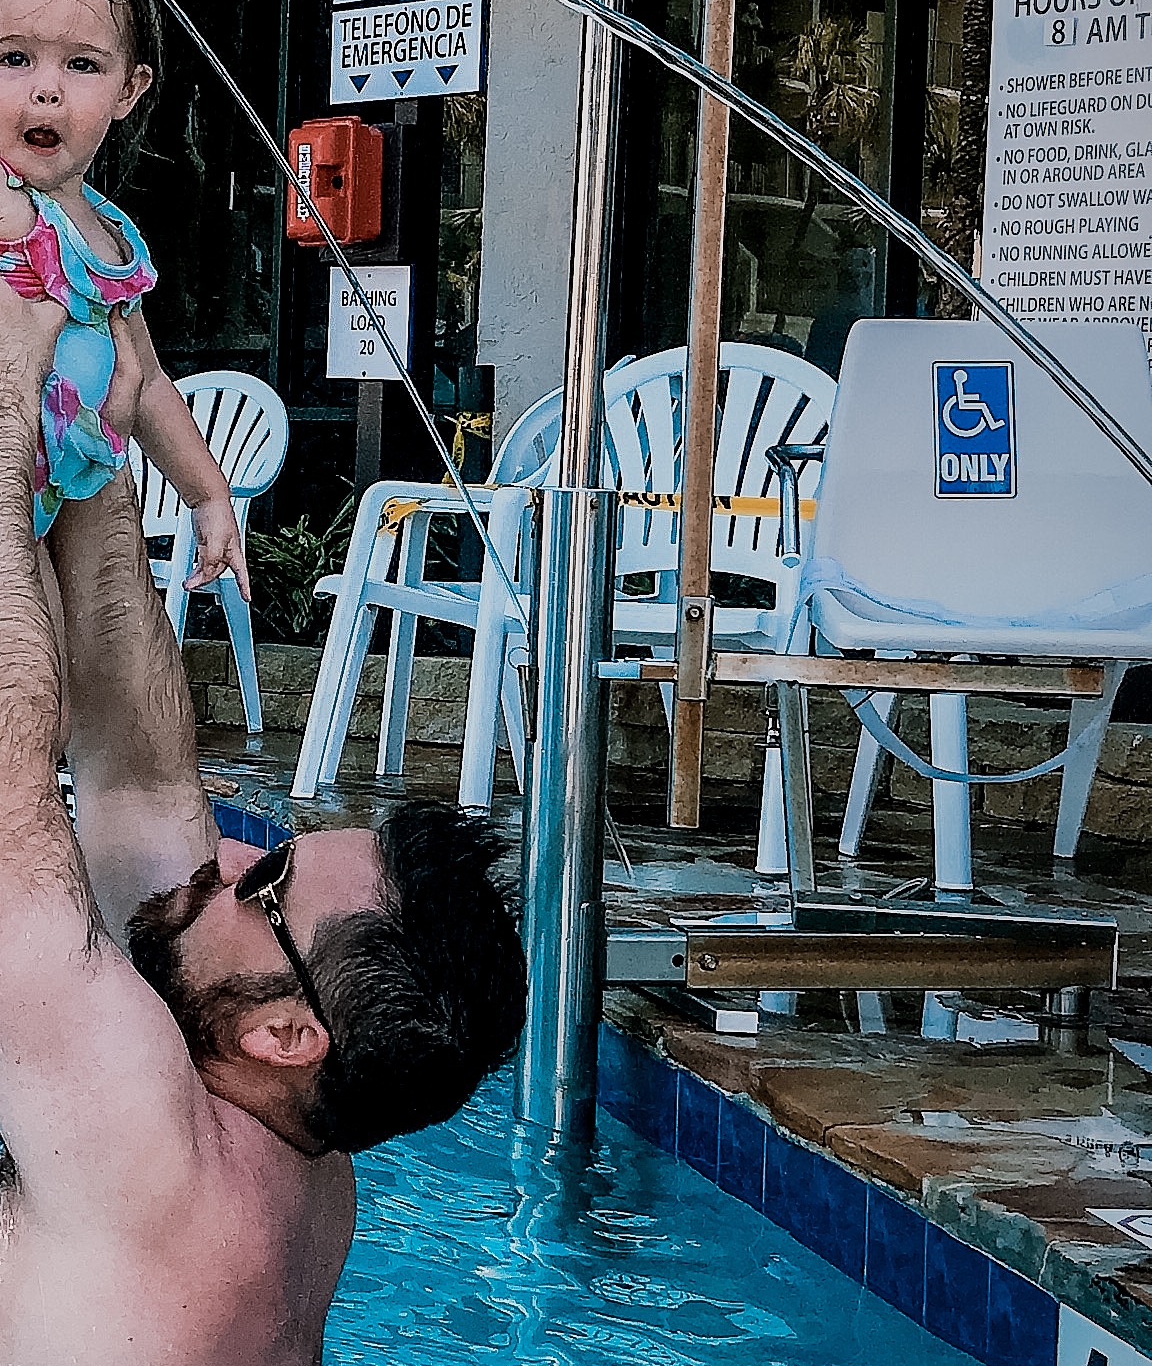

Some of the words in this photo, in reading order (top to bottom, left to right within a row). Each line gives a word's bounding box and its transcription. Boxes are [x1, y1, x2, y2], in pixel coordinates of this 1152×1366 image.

[446, 2, 473, 29] DE
[1051, 19, 1066, 45] 8
[1086, 14, 1127, 45] AM
[1135, 11, 1152, 39] T
[341, 31, 467, 68] EMERGENCIA
[1006, 73, 1066, 94] SHOWER
[1069, 68, 1123, 89] BEFORE
[1005, 101, 1027, 120] NO
[1029, 96, 1107, 118] LIFEGUARD
[1110, 93, 1133, 112] ON
[1004, 123, 1021, 139] AT
[1023, 120, 1058, 138] OWN
[1061, 118, 1096, 136] RISK.
[1003, 148, 1025, 165] NO
[1027, 145, 1071, 164] FOOD,
[1074, 141, 1122, 161] DRINK,
[1002, 169, 1017, 185] IN
[1019, 167, 1040, 184] OR
[1042, 164, 1105, 183] AROUND
[1107, 162, 1146, 180] AREA
[1001, 194, 1023, 211] DO
[1025, 193, 1056, 210] NOT
[1057, 189, 1130, 208] SWALLOW
[1000, 220, 1022, 236] NO
[1024, 218, 1075, 236] ROUGH
[1078, 215, 1140, 234] PLAYING
[999, 246, 1020, 262] NO
[1023, 244, 1089, 261] RUNNING
[998, 271, 1067, 288] CHILDREN
[1069, 269, 1111, 286] MUST
[1114, 268, 1152, 286] HAVE
[998, 297, 1065, 313] CHILDREN
[1069, 296, 1105, 312] WHO
[1108, 295, 1136, 312] ARE
[1139, 295, 1152, 310] N
[359, 339, 375, 356] 20
[940, 453, 1010, 482] ONLY
